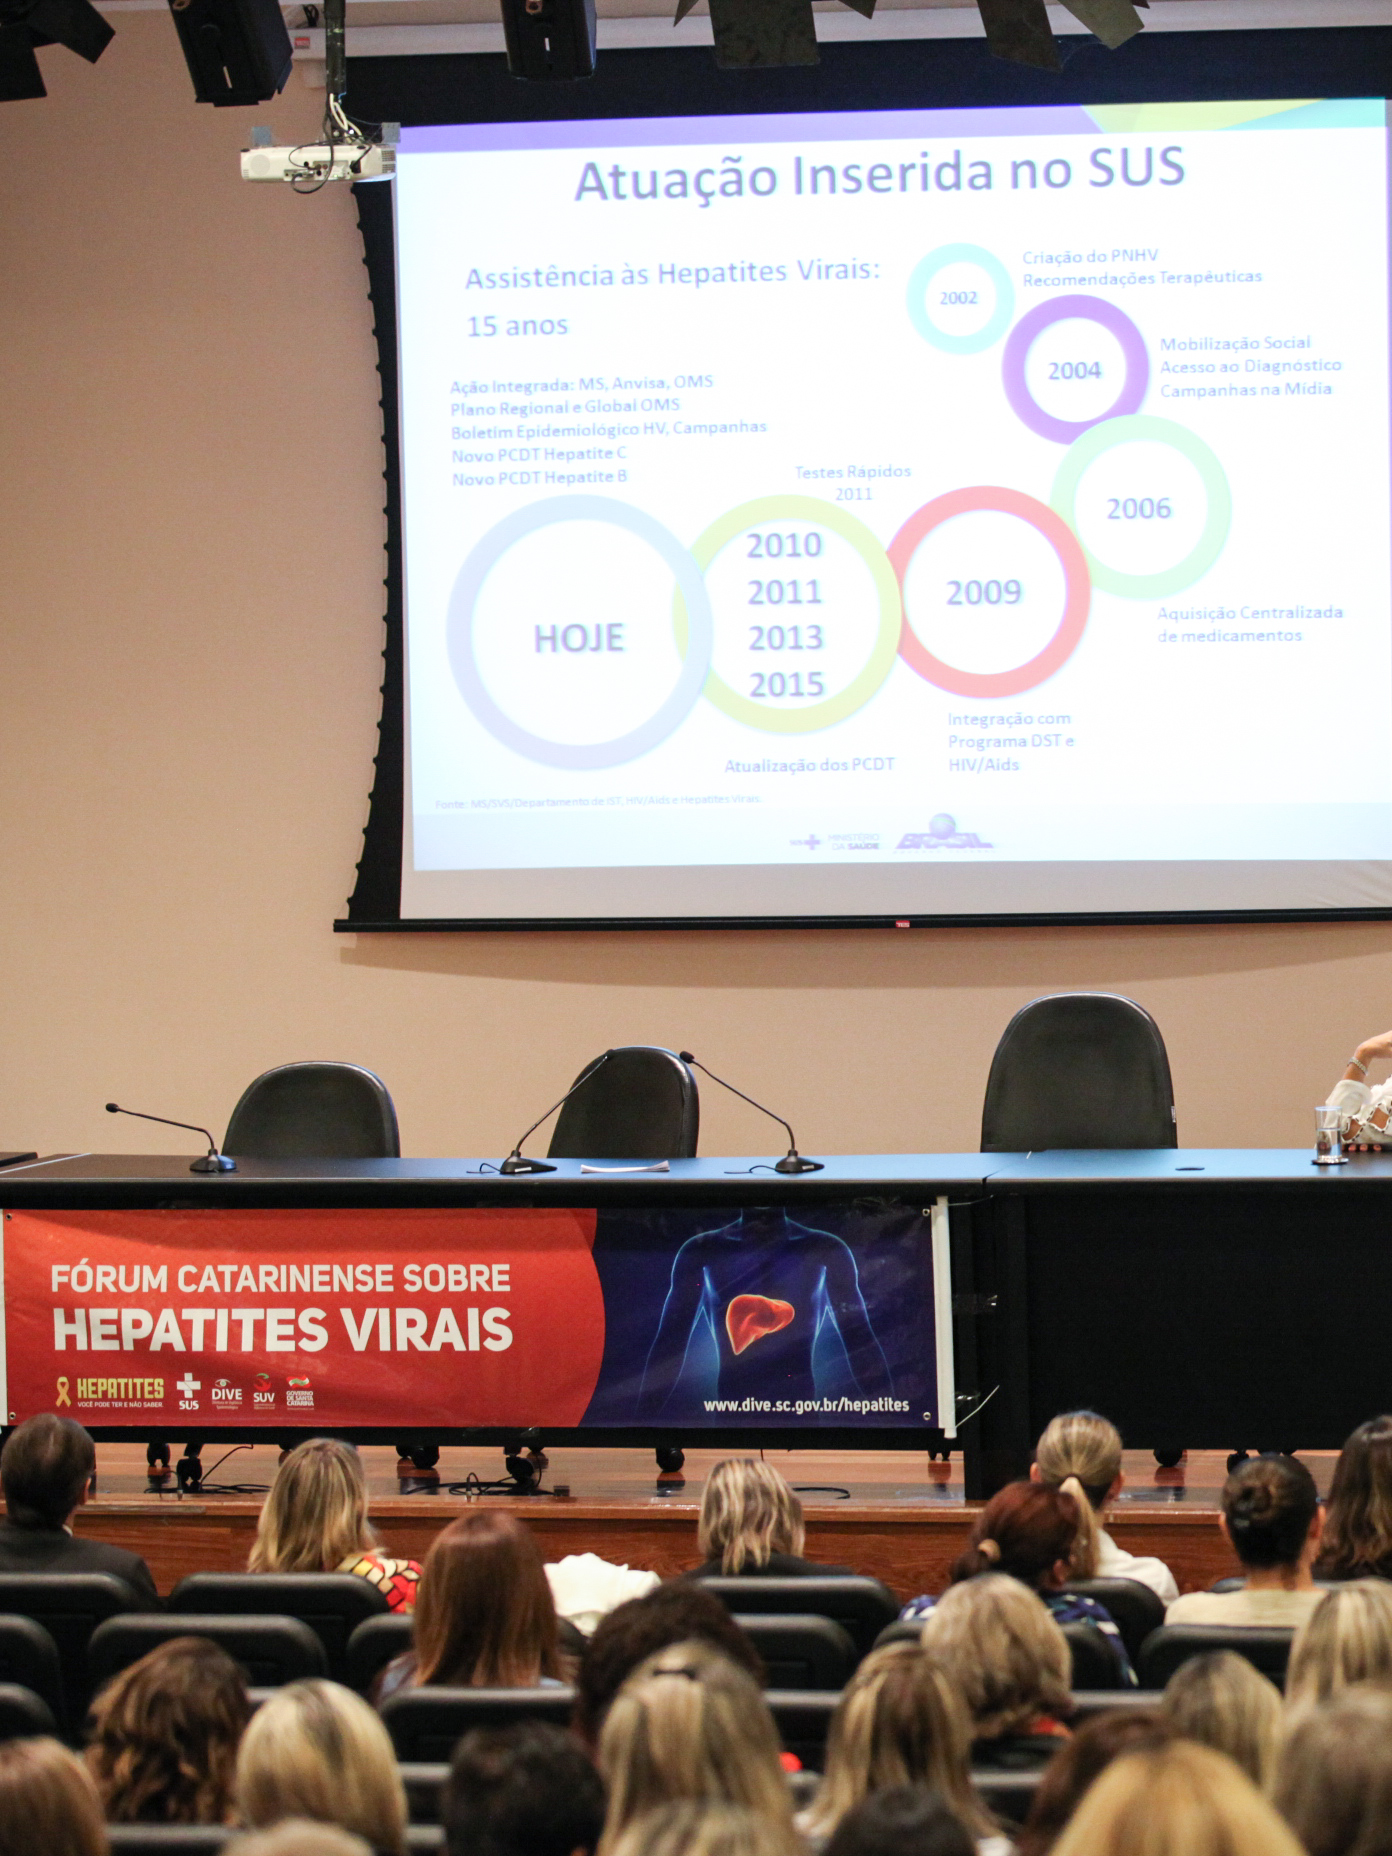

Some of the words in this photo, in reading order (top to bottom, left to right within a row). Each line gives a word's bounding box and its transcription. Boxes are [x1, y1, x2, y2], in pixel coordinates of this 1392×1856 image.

[575, 156, 777, 208] Atuação
[794, 150, 992, 195] Inserida
[1010, 157, 1071, 189] no
[1089, 145, 1184, 188] SUS
[1022, 249, 1082, 265] Criação
[1086, 250, 1107, 262] do
[1111, 249, 1159, 262] PNHV
[465, 266, 614, 290] Assistência
[620, 264, 649, 285] às
[658, 261, 787, 288] Hepatites
[797, 258, 880, 280] Virais:
[1023, 271, 1155, 288] Recomendações
[1159, 270, 1263, 286] Terapêuticas
[939, 292, 977, 305] 2002
[467, 316, 498, 337] 15
[505, 319, 568, 336] anos
[1160, 337, 1260, 353] Mobilização
[1264, 336, 1311, 350] Social
[1047, 362, 1103, 380] 2004
[1160, 361, 1215, 374] Acesso
[1219, 362, 1240, 373] ao
[1244, 358, 1342, 376] Diagnóstico
[450, 380, 488, 397] Ação
[492, 379, 575, 396] Integrada:
[579, 378, 609, 392] MS,
[612, 376, 670, 391] Anvisa,
[673, 375, 713, 388] OMS
[1160, 384, 1257, 400] Campanhas
[1260, 385, 1280, 397] na
[1285, 381, 1332, 396] Mídia
[451, 403, 495, 417] Plano
[499, 401, 569, 418] Regional
[573, 404, 581, 414] e
[585, 400, 637, 414] Global
[640, 399, 680, 412] OMS
[451, 425, 513, 440] Boletim
[516, 423, 640, 442] Epidemiológico
[643, 422, 670, 438] HV,
[673, 419, 767, 437] Campanhas
[452, 449, 495, 464] Novo
[498, 448, 541, 462] PCDT
[544, 447, 613, 465] Hepatite
[616, 446, 627, 459] C
[453, 473, 495, 487] Novo
[499, 472, 541, 486] PCDT
[544, 470, 614, 488] Hepatite
[617, 470, 627, 483] B
[795, 467, 843, 481] Testes
[848, 463, 911, 481] Rápidos
[835, 487, 872, 501] 2011
[1106, 497, 1172, 520] 2006
[746, 532, 822, 559] 2010
[747, 579, 821, 606] 2011
[946, 579, 1022, 606] 2009
[1157, 606, 1236, 623] Aquisição
[1240, 605, 1343, 620] Centralizada
[534, 623, 625, 653] HOJE
[748, 625, 824, 651] 2013
[1157, 630, 1178, 643] de
[1181, 629, 1302, 643] medicamentos
[749, 672, 824, 698] 2015
[947, 712, 1034, 729] Integração
[1037, 713, 1071, 725] com
[948, 735, 1027, 752] Programa
[1032, 734, 1061, 747] DST
[1065, 736, 1075, 747] e
[724, 759, 816, 776] Atualização
[819, 758, 848, 773] dos
[852, 757, 895, 772] PCDT
[948, 757, 1020, 774] HIV/Aids
[51, 1258, 167, 1293] FÓRUM
[177, 1264, 394, 1293] CATARINENSE
[403, 1263, 510, 1293] SOBRE
[53, 1307, 328, 1352] HEPATITES
[341, 1307, 513, 1352] VIRAIS
[77, 1378, 164, 1398] HEPATITES
[212, 1389, 242, 1400] DIVE
[254, 1393, 275, 1402] SUV
[179, 1401, 199, 1410] SUS
[704, 1397, 910, 1415] www.dive.sc.gov.br/hepatites
